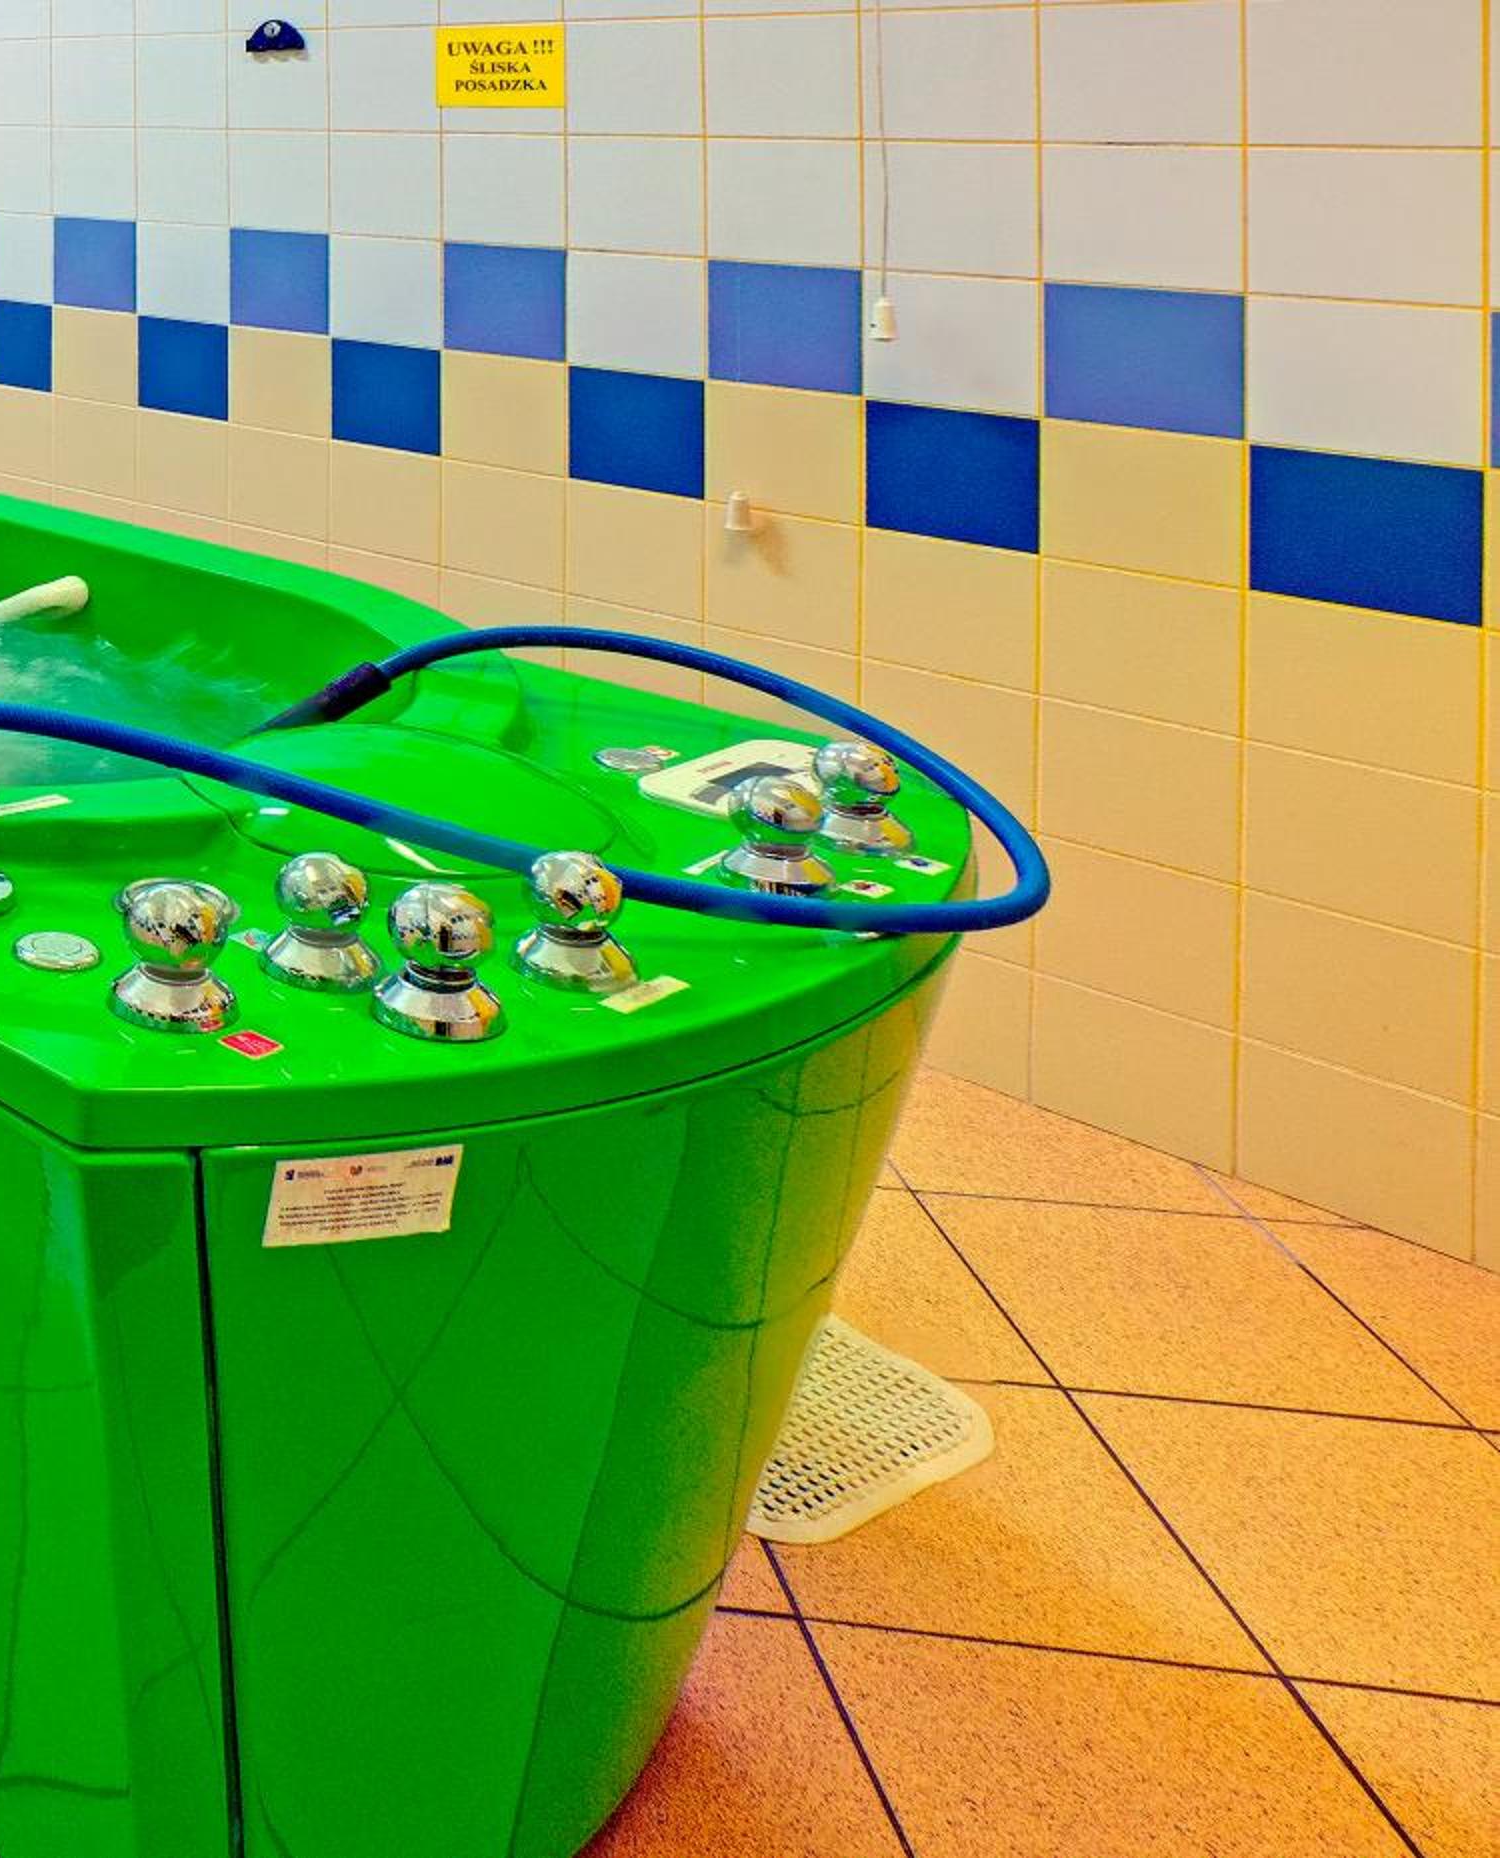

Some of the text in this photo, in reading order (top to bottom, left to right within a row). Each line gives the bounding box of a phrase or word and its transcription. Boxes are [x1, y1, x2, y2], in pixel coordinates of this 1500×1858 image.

[447, 39, 554, 57] UWAGA !!!
[469, 59, 532, 75] ŚLISKA
[454, 79, 548, 92] POSADZKA
